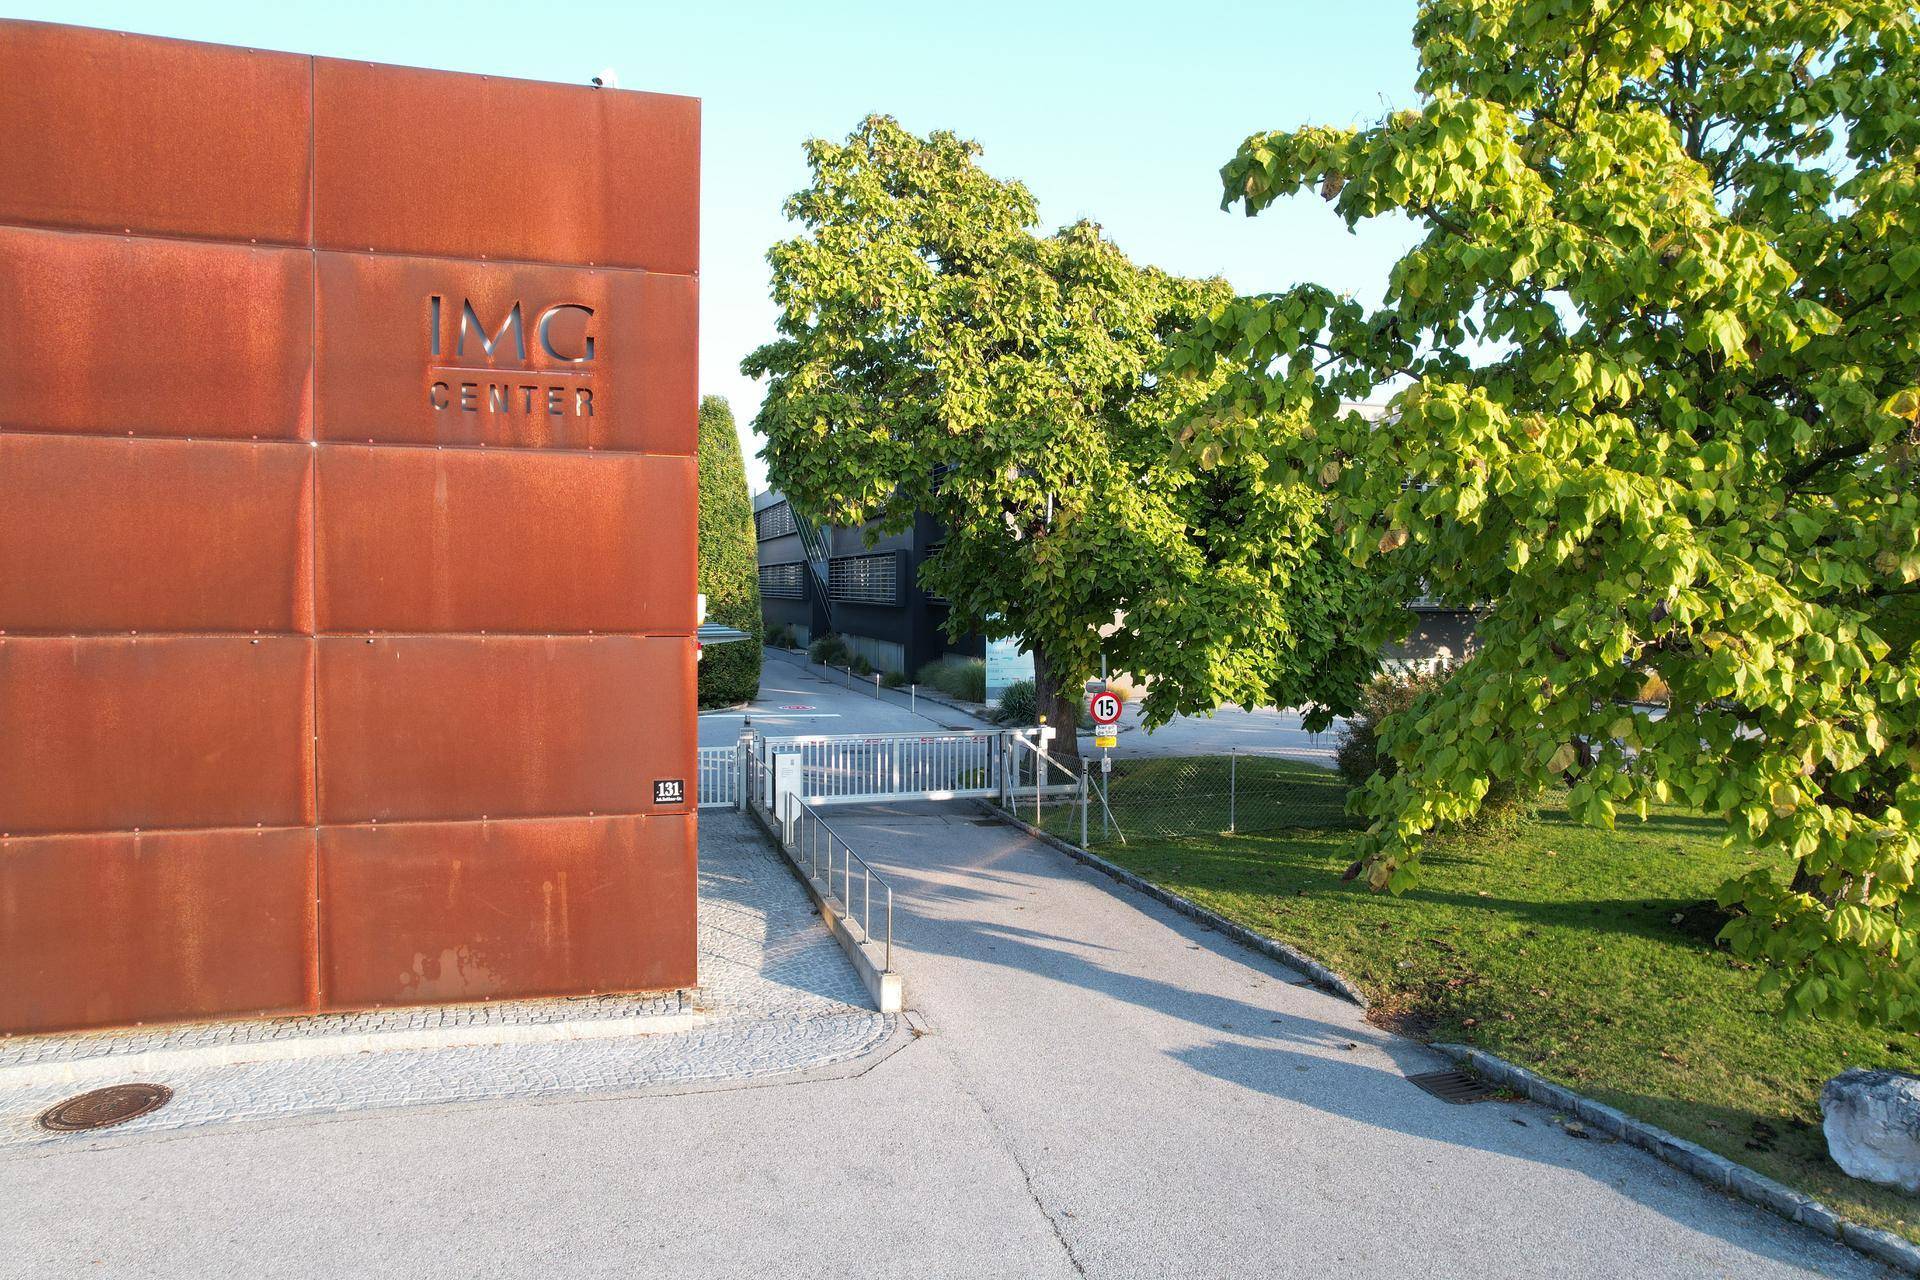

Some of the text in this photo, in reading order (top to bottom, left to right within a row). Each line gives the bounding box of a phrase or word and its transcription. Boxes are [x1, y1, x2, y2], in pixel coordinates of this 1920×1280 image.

[432, 296, 595, 363] IMG
[431, 381, 594, 416] CENTER
[1098, 699, 1114, 717] 15
[658, 781, 680, 796] 131
